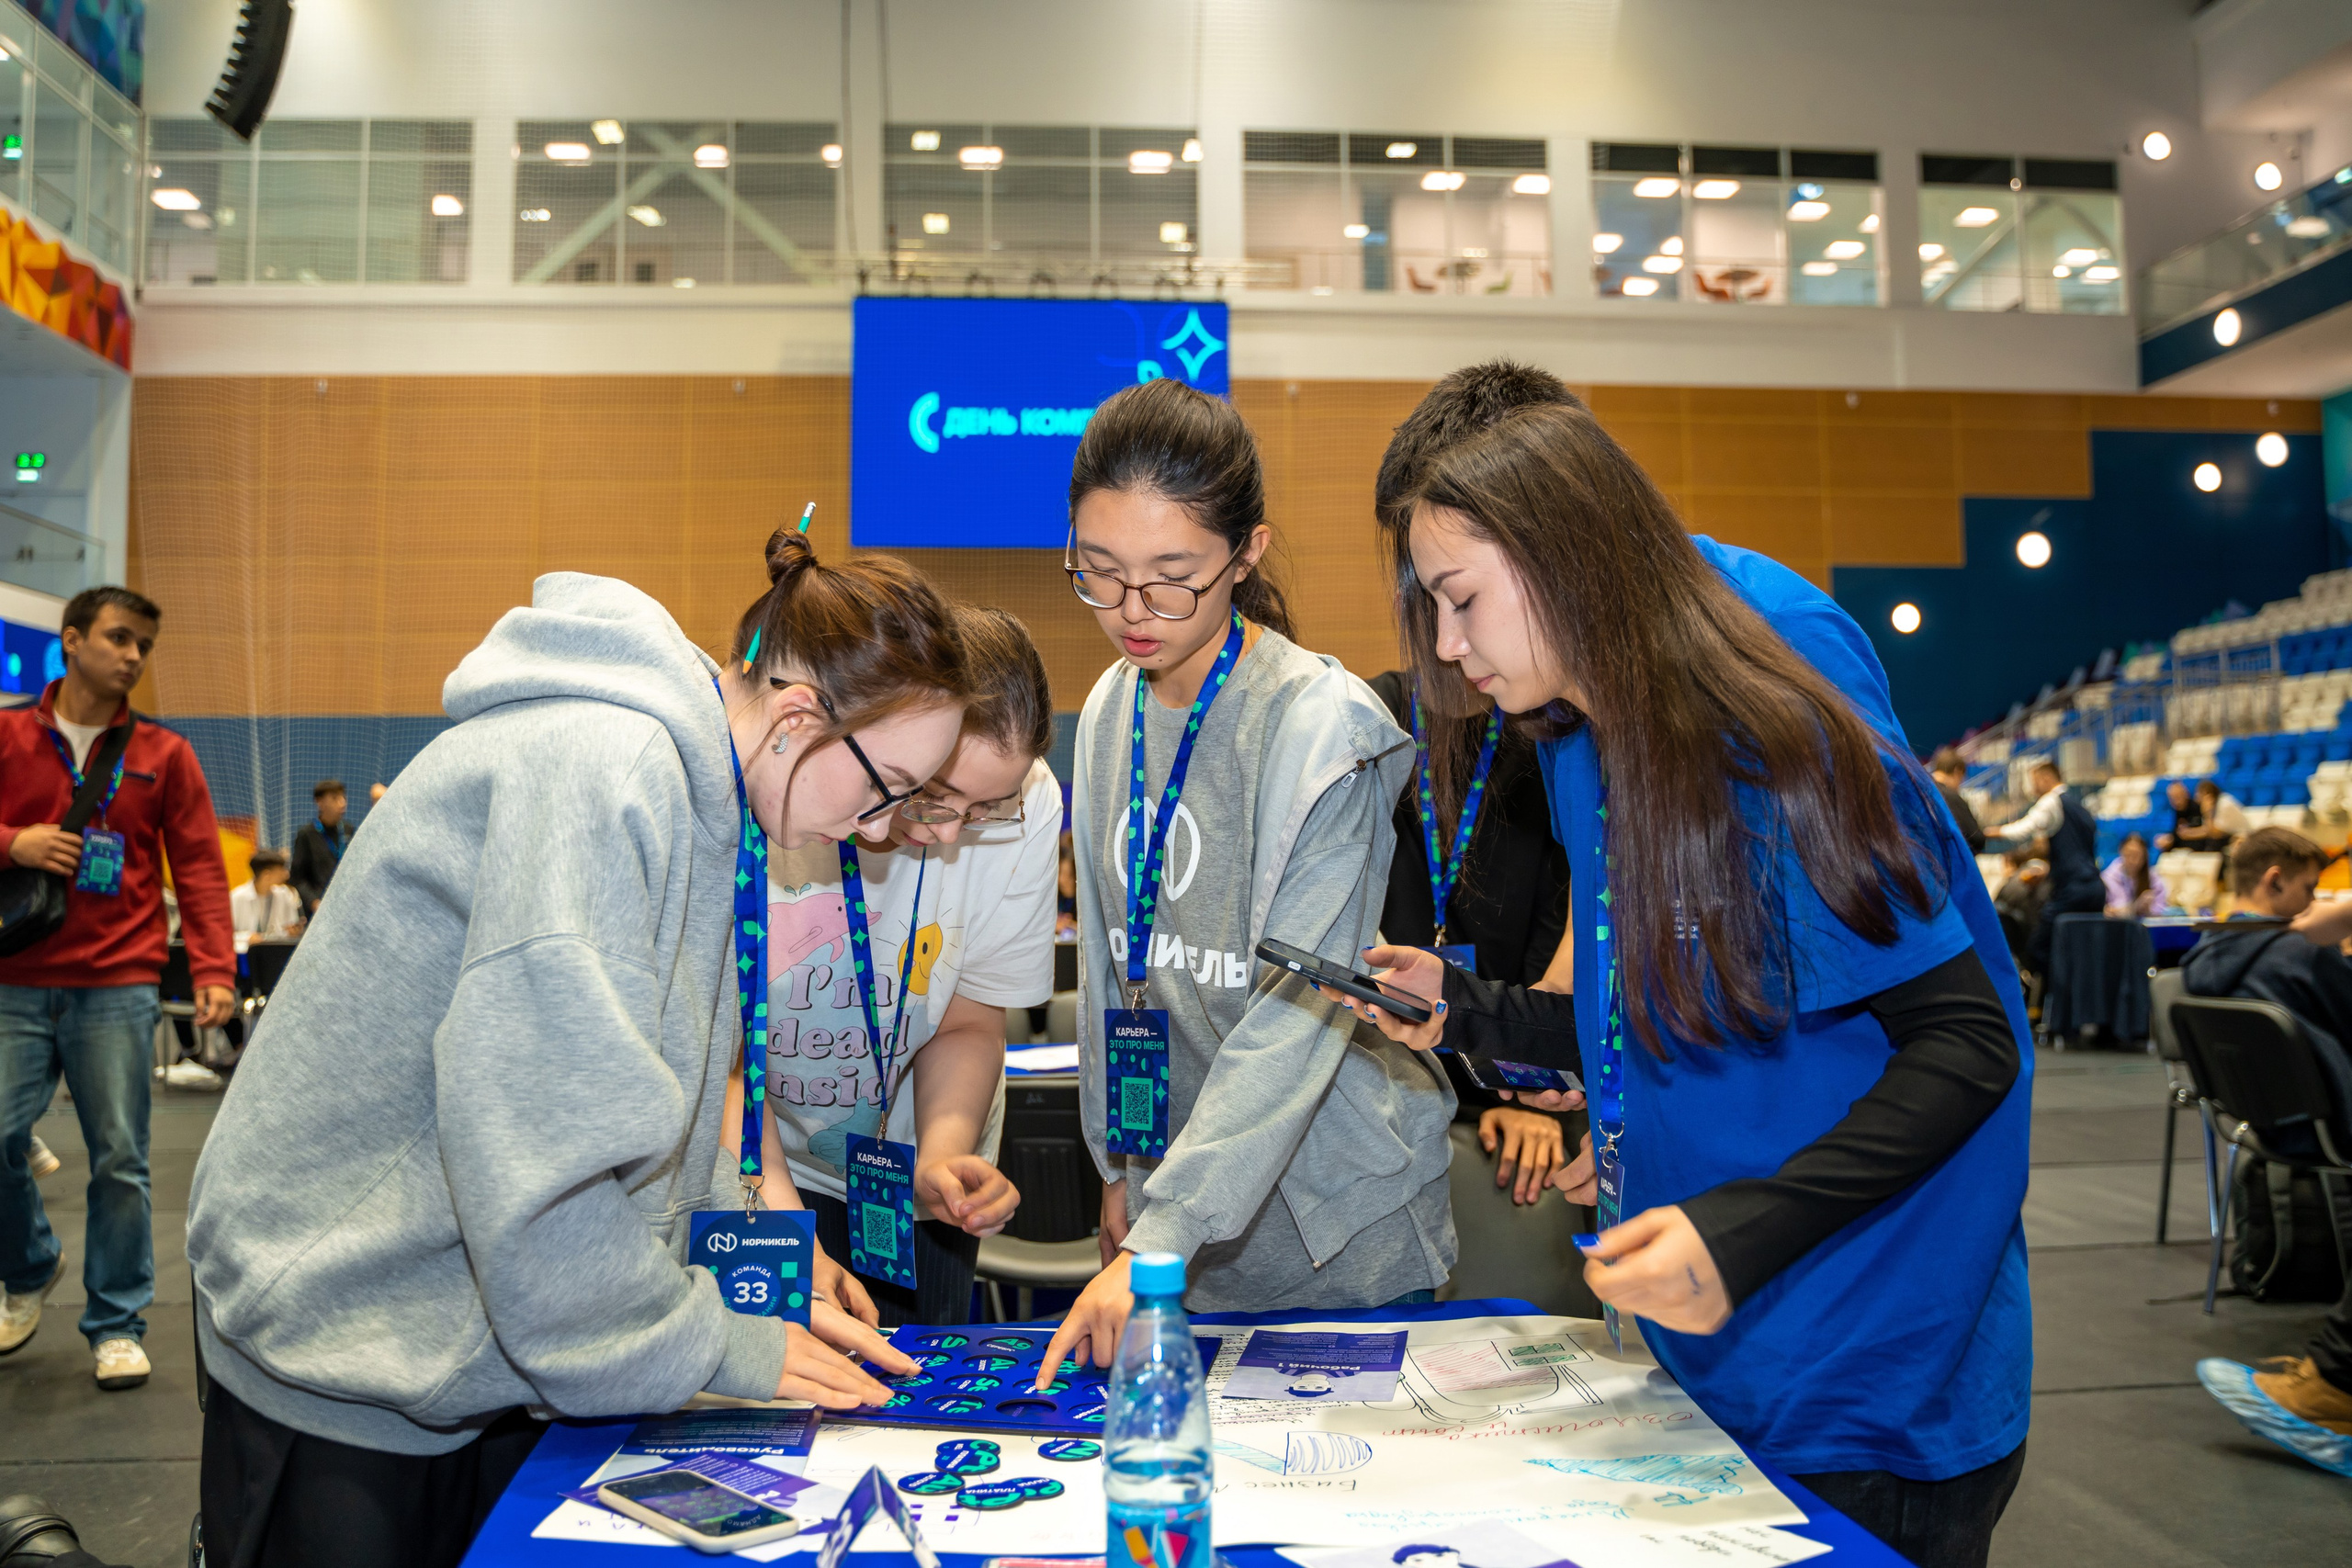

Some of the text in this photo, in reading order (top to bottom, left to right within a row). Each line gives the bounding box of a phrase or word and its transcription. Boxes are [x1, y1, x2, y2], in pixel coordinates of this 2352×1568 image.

[943, 407, 1019, 439] ДЕНЬ
[1115, 1027, 1149, 1037] КАРЬЕРА
[1109, 1039, 1165, 1051] ЭТО ПРО МЕНЯ
[765, 1064, 900, 1108] nsid
[857, 1152, 893, 1168] КАРЬЕРА
[850, 1163, 910, 1185] ЭТО ПРО МЕНЯ
[741, 1237, 799, 1247] НОРНИКЕЛЬ
[731, 1265, 772, 1279] КОМАНДА
[733, 1281, 768, 1303] 33
[1288, 1362, 1361, 1371] Рабочий
[946, 1401, 983, 1414] Te
[644, 1446, 785, 1455] Руководитель
[1244, 1480, 1356, 1492] Бизнес
